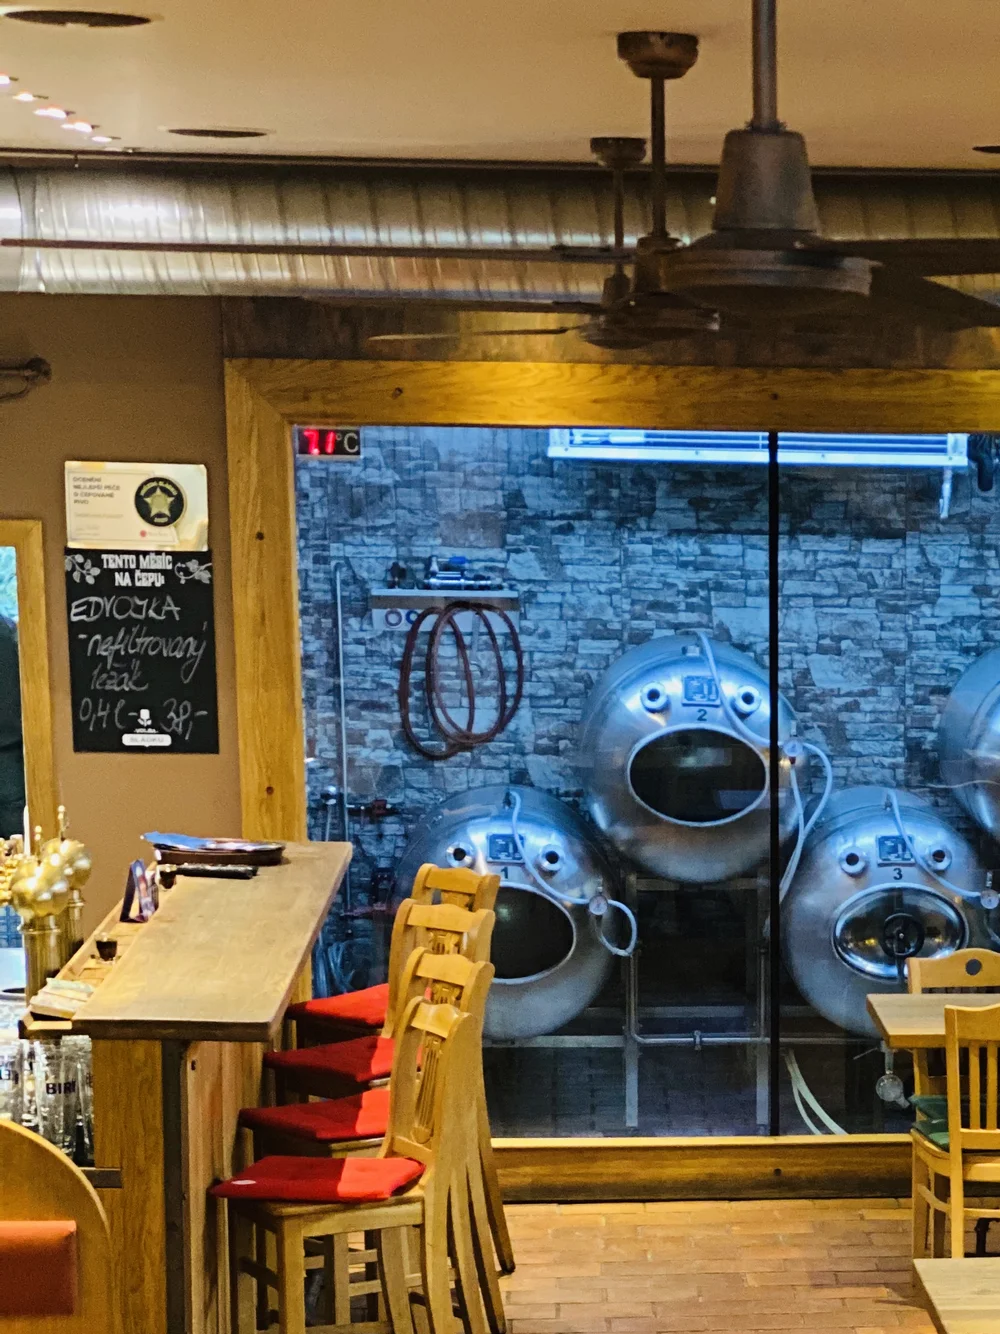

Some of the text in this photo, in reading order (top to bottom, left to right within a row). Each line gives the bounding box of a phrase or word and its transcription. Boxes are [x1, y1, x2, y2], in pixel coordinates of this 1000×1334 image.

[101, 552, 173, 569] TENTO MĚSÍC
[115, 572, 132, 586] NA
[697, 709, 707, 721] 2
[501, 867, 508, 879] 1
[893, 868, 903, 880] 3
